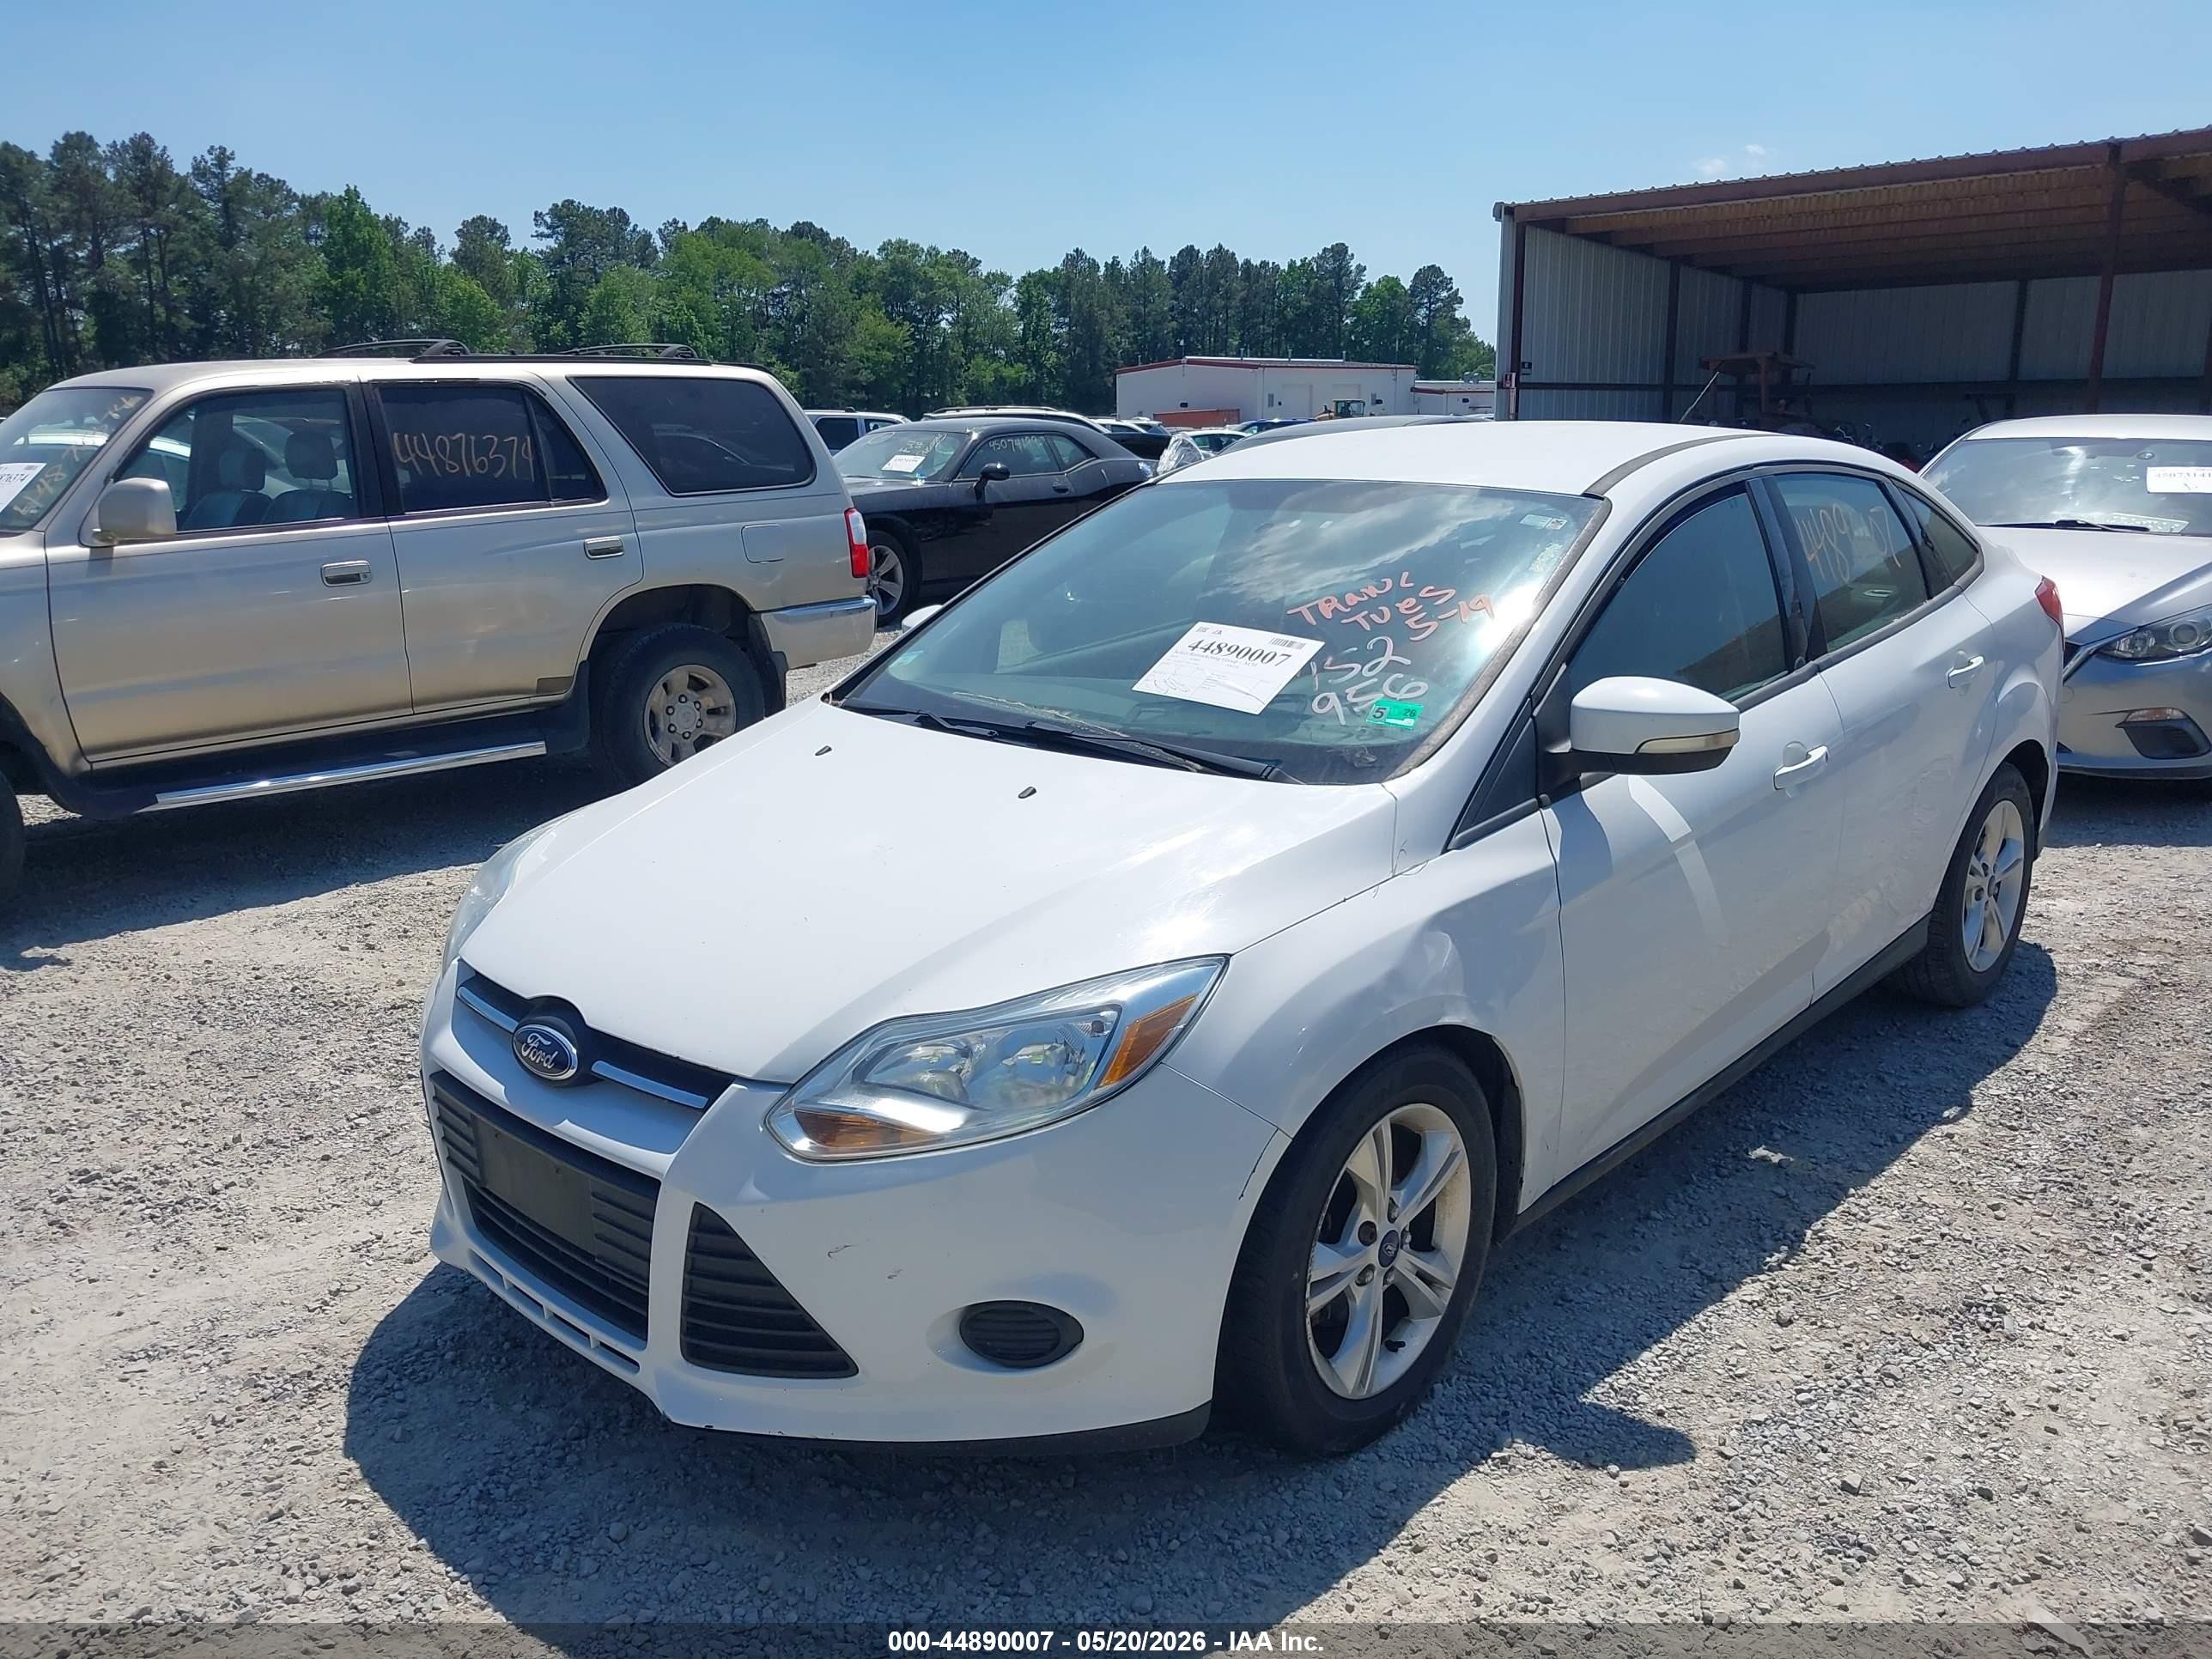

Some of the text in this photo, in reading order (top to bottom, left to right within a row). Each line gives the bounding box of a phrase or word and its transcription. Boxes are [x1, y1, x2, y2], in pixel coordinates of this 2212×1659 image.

[392, 432, 535, 482] 44876374
[1188, 639, 1292, 667] 44890007
[1310, 635, 1412, 690] 152
[1311, 673, 1429, 726] 956
[1371, 707, 1387, 719] 5
[521, 1032, 559, 1069] Ford
